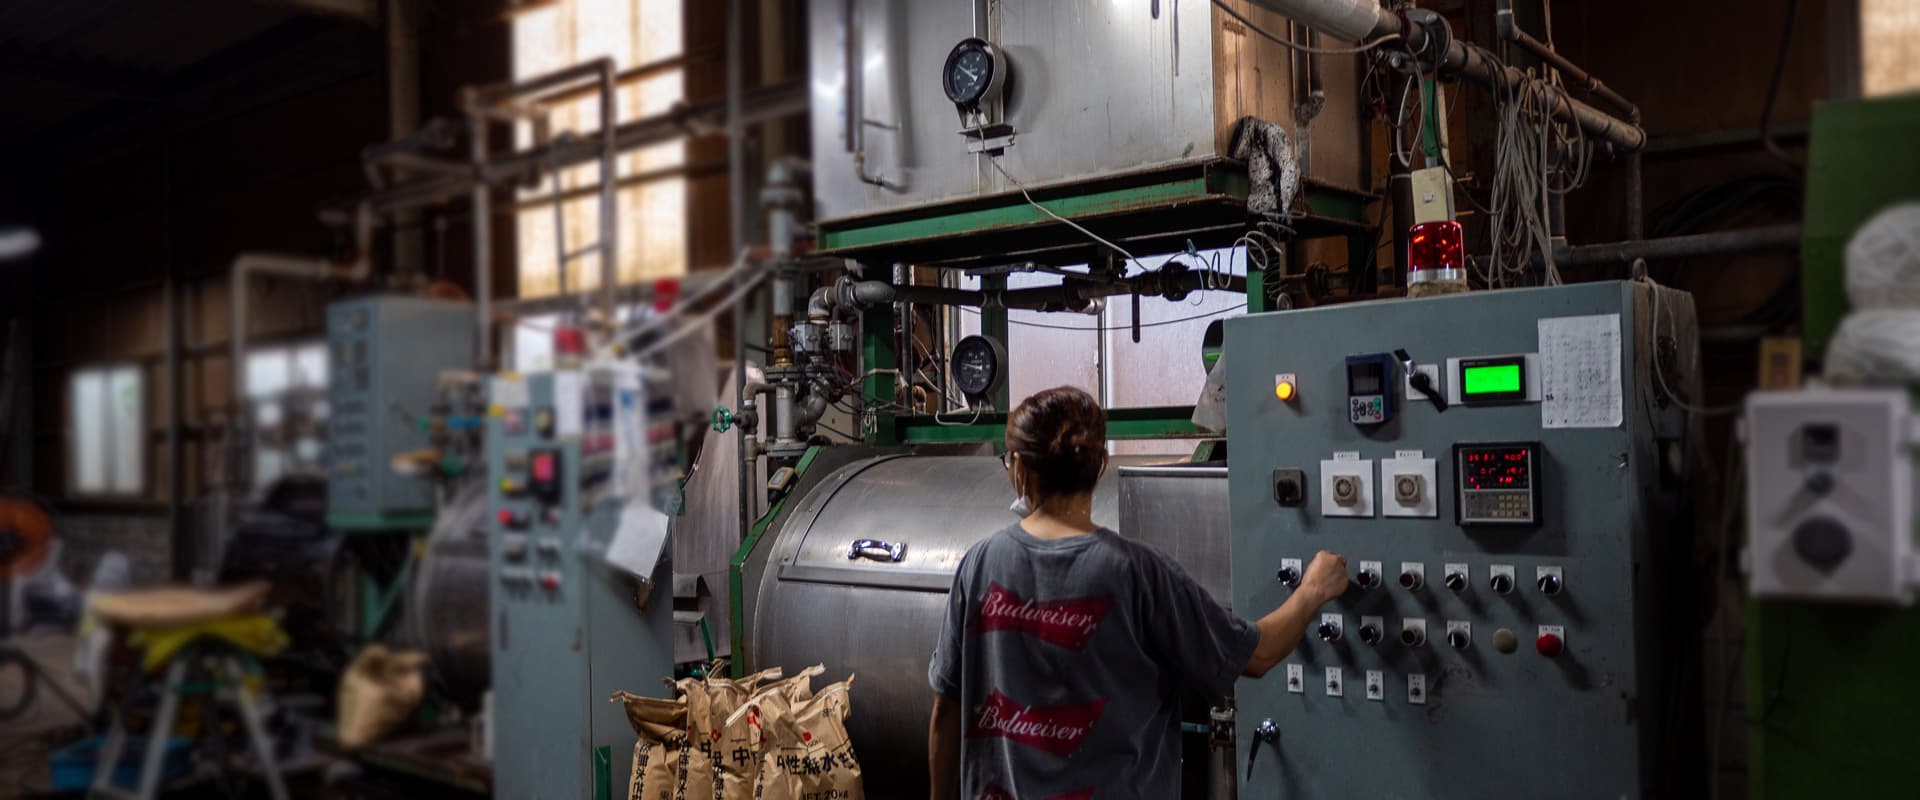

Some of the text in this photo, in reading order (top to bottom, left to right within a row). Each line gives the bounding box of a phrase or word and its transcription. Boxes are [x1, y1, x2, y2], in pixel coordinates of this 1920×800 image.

[976, 591, 1097, 635] Budweiser
[973, 704, 1095, 741] Budweiser
[733, 742, 758, 768] 中
